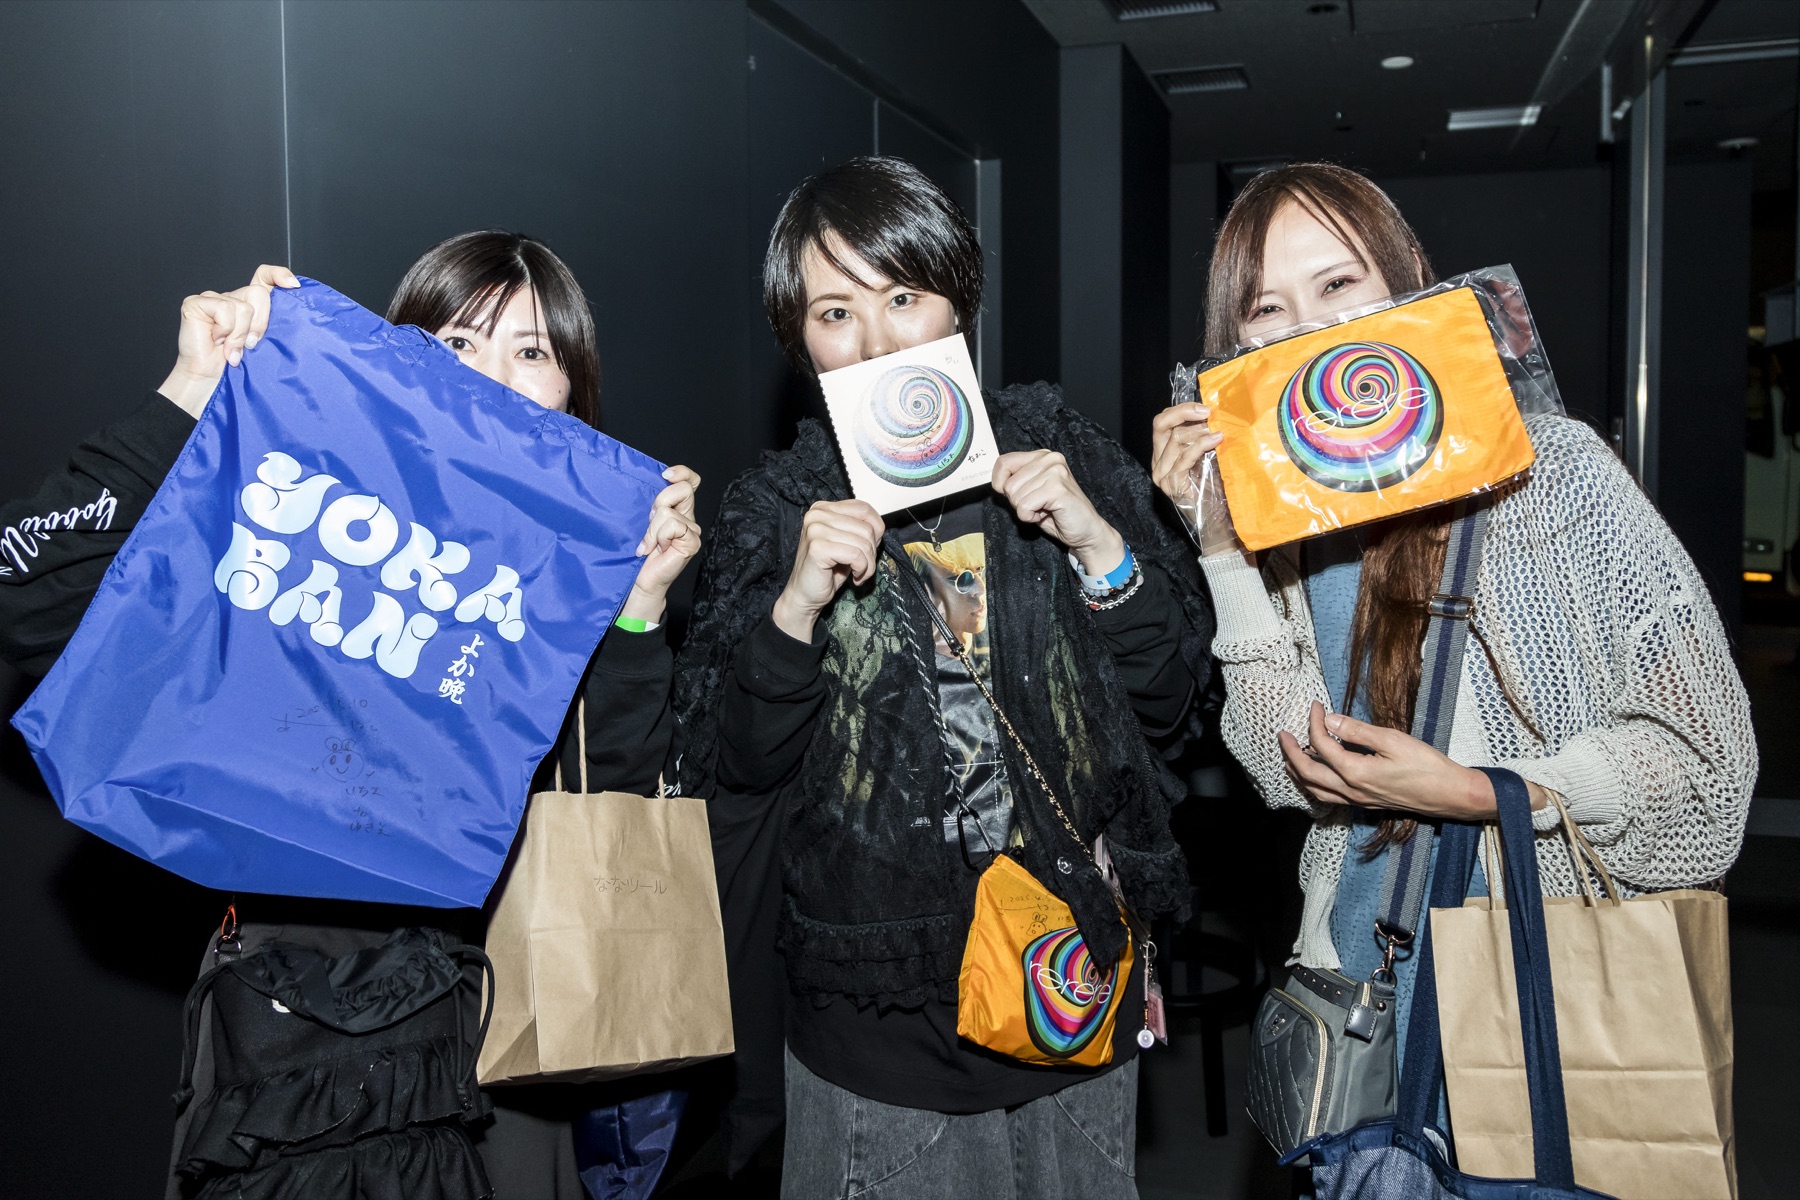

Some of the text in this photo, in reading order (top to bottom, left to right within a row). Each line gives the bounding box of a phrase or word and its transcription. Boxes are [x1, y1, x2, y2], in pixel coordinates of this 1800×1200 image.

[1291, 387, 1431, 440] rerere
[240, 451, 526, 643] YOKA
[214, 521, 439, 679] BAN
[438, 634, 485, 705] よか晩
[594, 875, 667, 894] ななツール
[1029, 960, 1112, 1004] rerere
